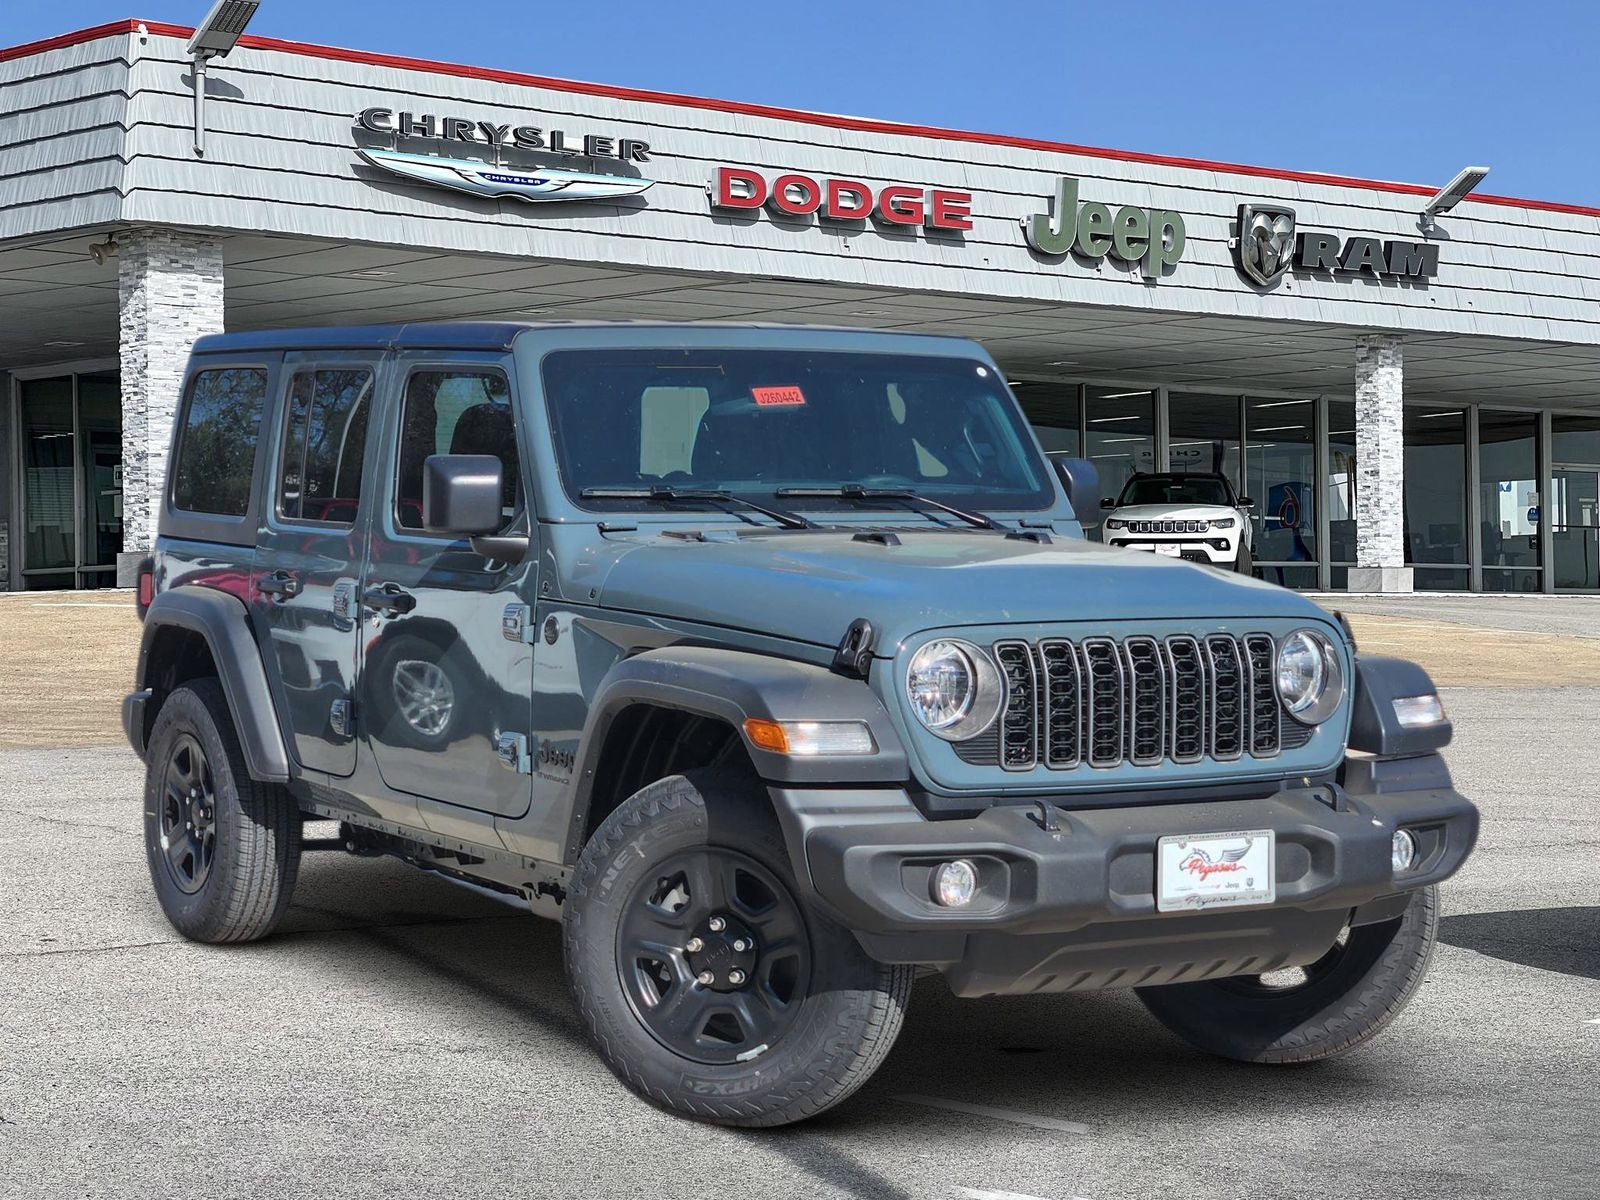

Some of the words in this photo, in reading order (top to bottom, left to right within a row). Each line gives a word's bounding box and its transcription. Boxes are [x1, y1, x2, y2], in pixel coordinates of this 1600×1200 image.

[356, 106, 652, 163] CHRYSLER
[484, 174, 541, 185] CHRYSLER
[712, 166, 974, 232] DODGE
[1024, 177, 1187, 279] Jeep
[1298, 232, 1439, 278] RAM
[760, 391, 802, 404] J260442
[1188, 858, 1247, 882] Pegasus
